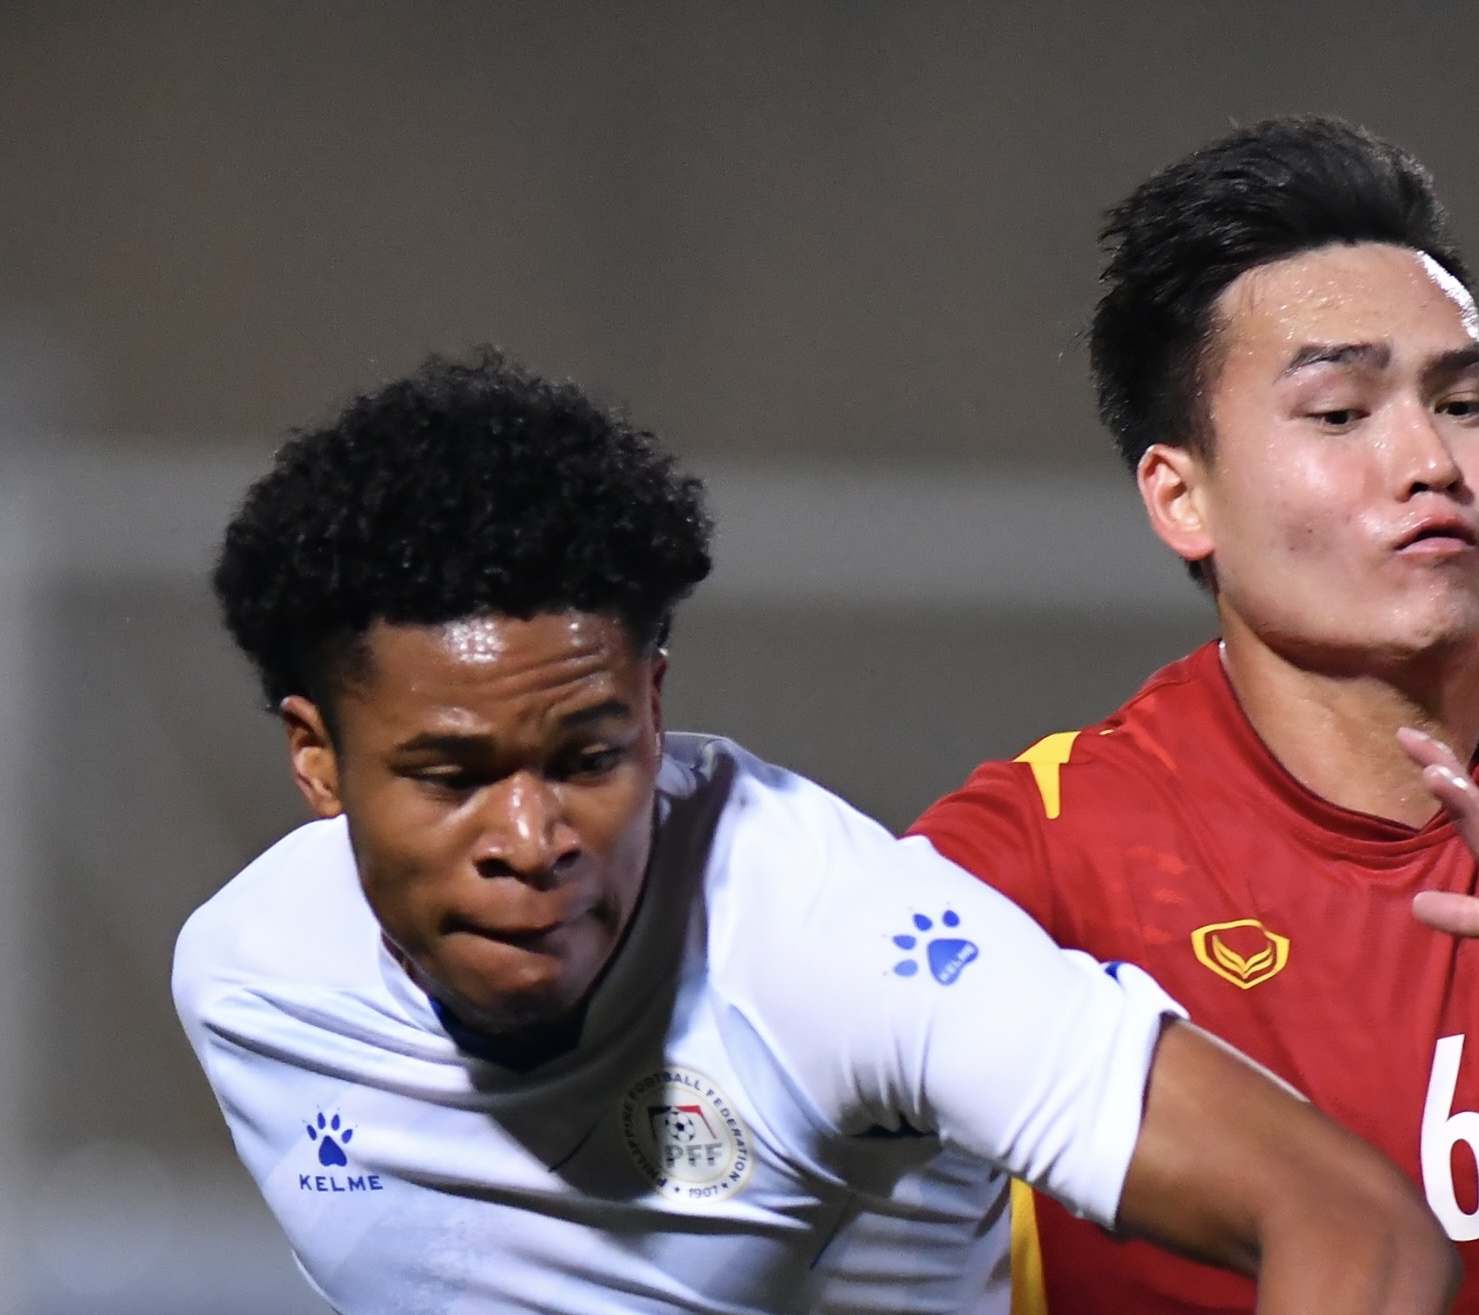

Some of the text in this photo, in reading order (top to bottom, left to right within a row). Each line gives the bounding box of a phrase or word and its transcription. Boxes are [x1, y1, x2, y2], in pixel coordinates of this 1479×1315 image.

[705, 1088, 749, 1183] FEDERATION
[664, 1142, 723, 1168] PFF
[299, 1173, 384, 1192] KELME
[687, 1185, 719, 1199] 1907
